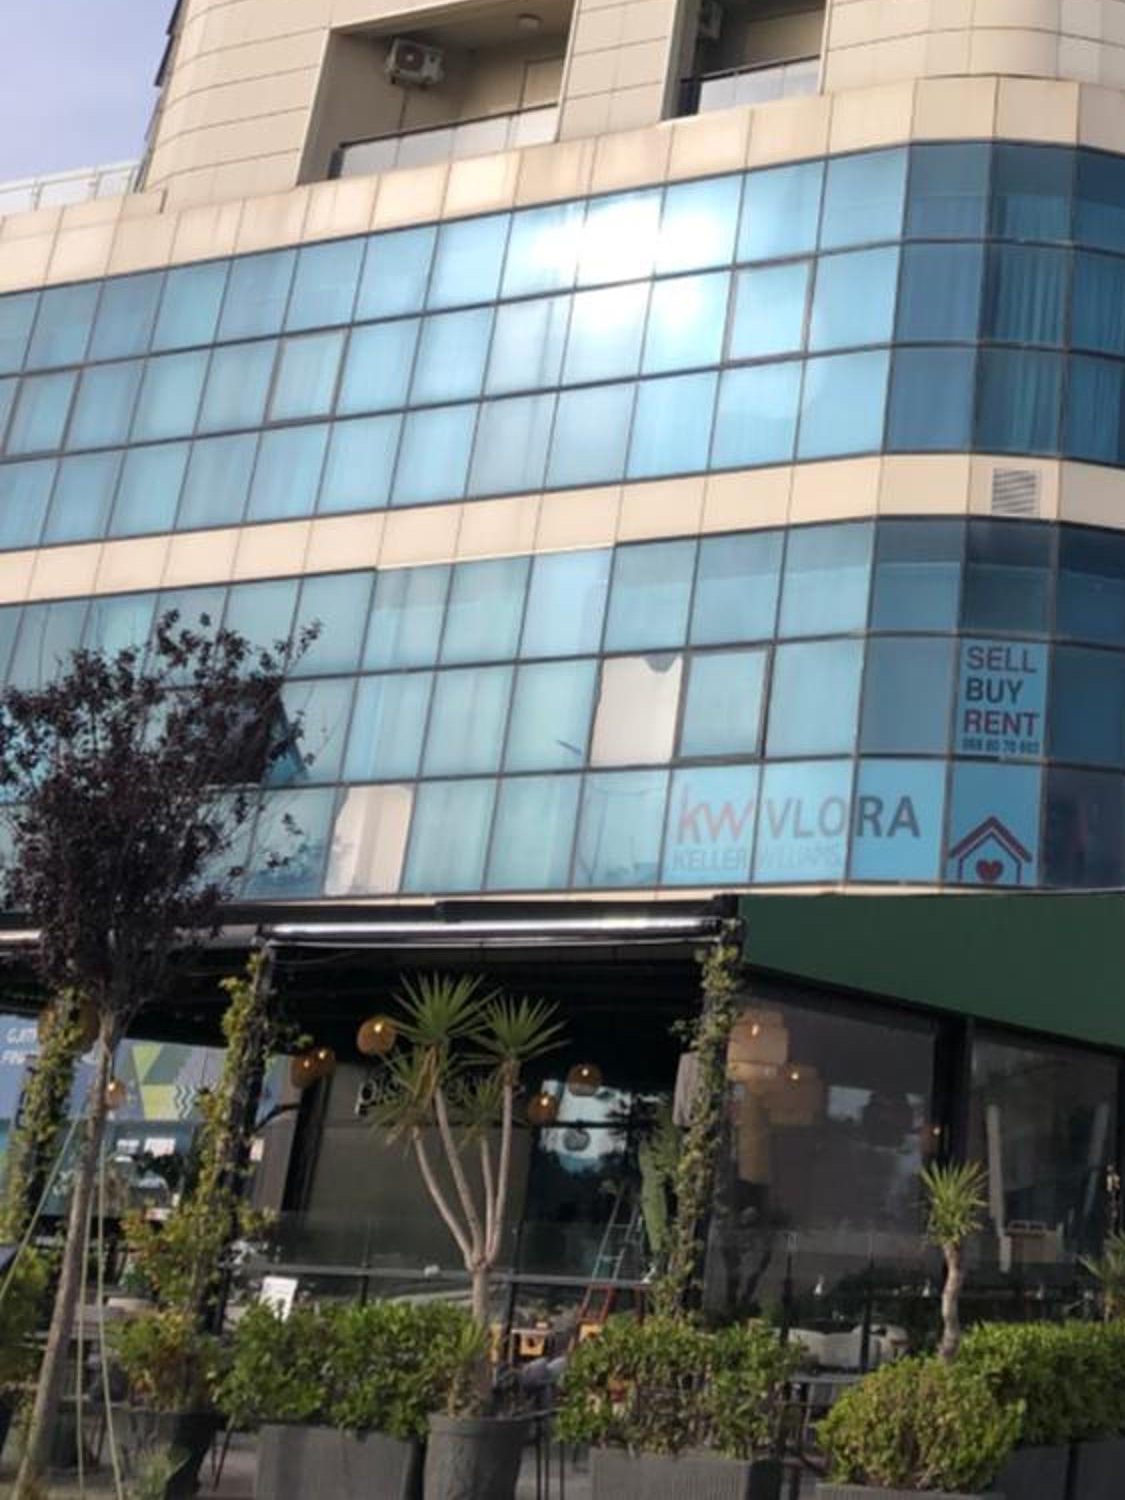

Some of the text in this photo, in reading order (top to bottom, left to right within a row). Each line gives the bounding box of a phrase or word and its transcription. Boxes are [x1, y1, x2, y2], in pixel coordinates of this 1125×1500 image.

[966, 645, 1037, 673] SELL
[965, 677, 1024, 704] BUY
[964, 708, 1040, 737] RENT
[767, 796, 921, 838] VLORA
